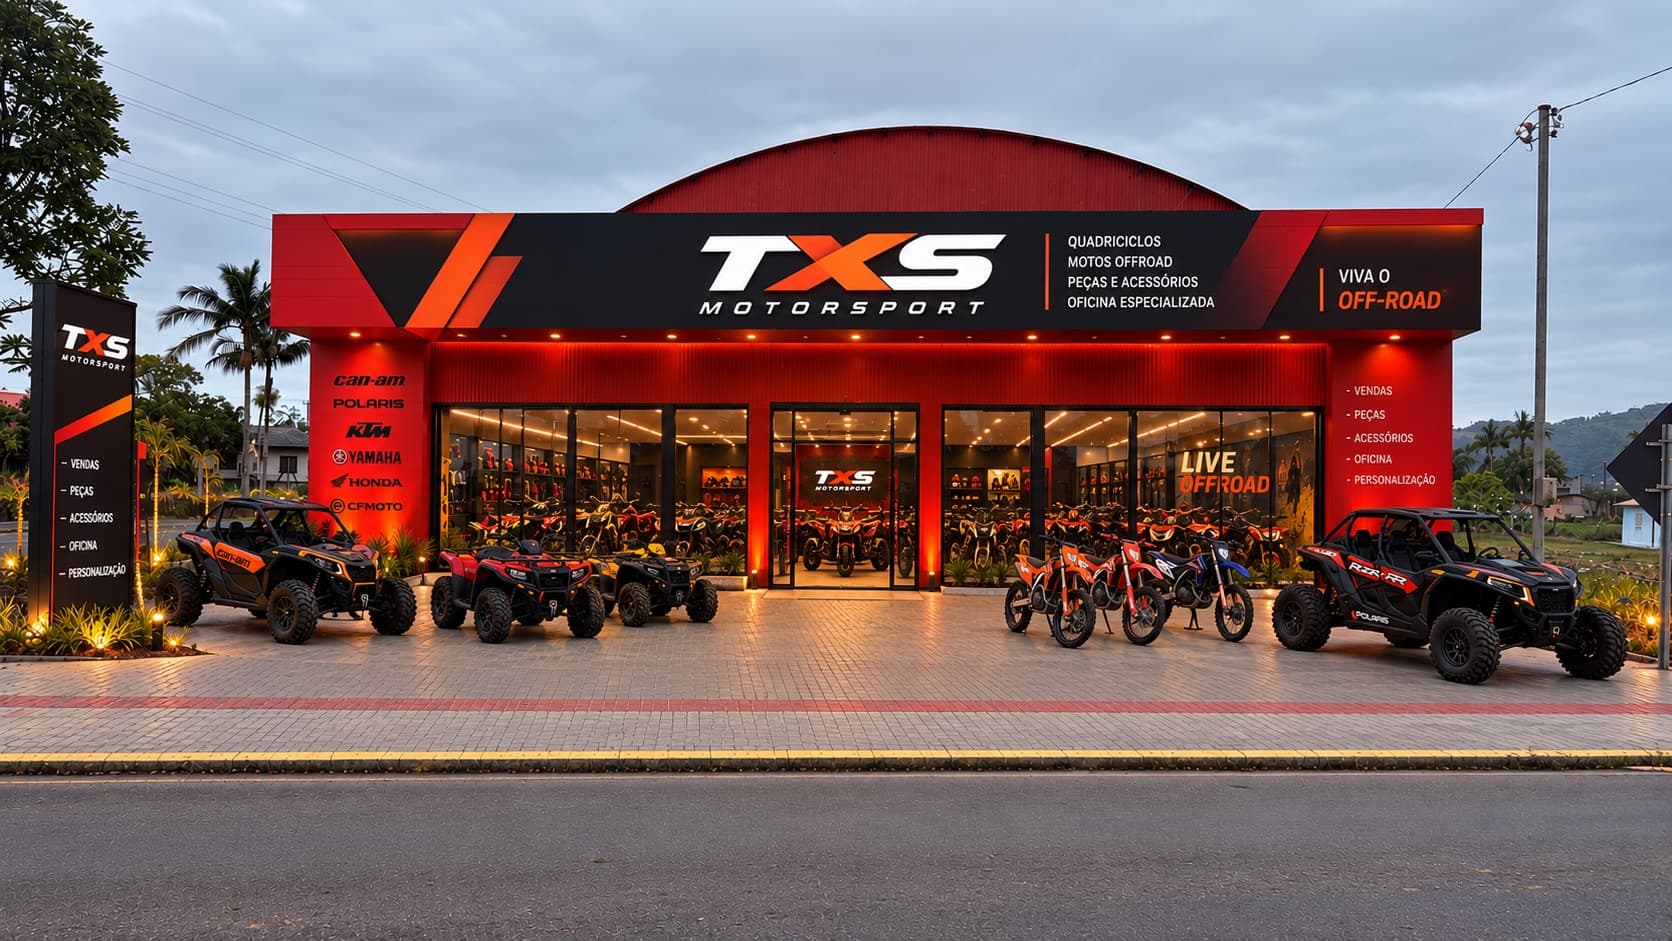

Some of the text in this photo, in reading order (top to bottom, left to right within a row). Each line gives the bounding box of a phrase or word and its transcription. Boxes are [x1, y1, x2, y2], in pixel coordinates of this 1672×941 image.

[1067, 235, 1162, 249] QUADRICICLOS
[700, 233, 1007, 291] TXS
[1067, 255, 1173, 268] MOTOS OFFROAD
[1067, 273, 1199, 291] PEÇAS E ACESSÓRIOS
[1339, 268, 1391, 283] VIVA O
[1067, 296, 1215, 308] OFICINA ESPECIALIZADA
[1338, 290, 1442, 310] OFF-ROAD
[699, 301, 985, 315] MOTORSPORT
[61, 323, 131, 360] TXS
[61, 353, 128, 372] MOTORSPORT
[1354, 385, 1393, 396] VENDAS
[333, 398, 405, 409] POLARIS
[1354, 409, 1386, 422] PEÇAS
[345, 422, 392, 438] KTM
[1354, 430, 1414, 443] ACESSÓRIOS
[70, 458, 100, 470] VENDAS
[349, 450, 402, 464] YAMAHA
[1181, 451, 1237, 473] LIVE
[1354, 454, 1393, 464] OFICINA
[349, 477, 403, 487] HONDA
[815, 470, 876, 485] TXS
[1180, 475, 1271, 494] OFFROAD
[69, 485, 95, 499] PEÇAS
[347, 502, 403, 511] CFMOTO
[69, 510, 114, 523] ACESSÓRIOS
[68, 540, 98, 552] OFICINA
